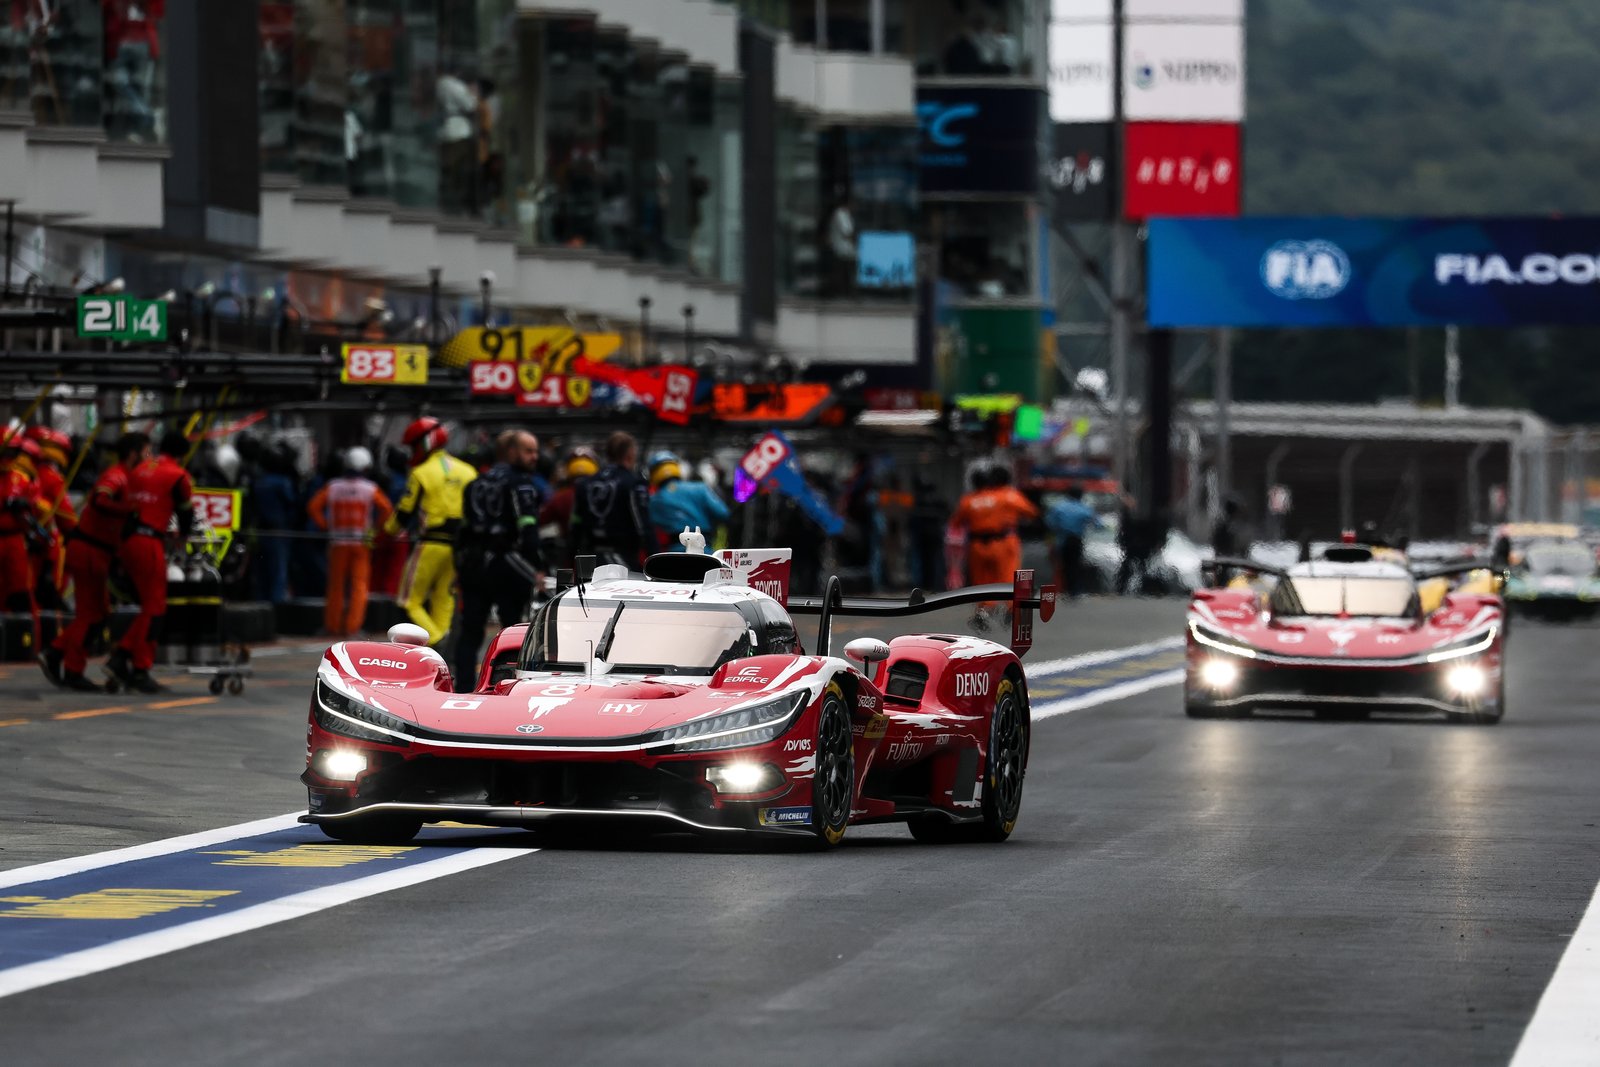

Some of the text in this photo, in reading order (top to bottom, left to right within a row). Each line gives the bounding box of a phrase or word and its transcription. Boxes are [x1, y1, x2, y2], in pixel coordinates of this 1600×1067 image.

[1265, 251, 1341, 289] FIA
[1435, 252, 1600, 285] FIA.CO
[480, 328, 526, 362] 91
[349, 349, 396, 379] 83
[472, 362, 516, 390] 50
[522, 376, 564, 402] 1
[742, 437, 787, 482] 50
[592, 586, 689, 596] DENSO
[754, 580, 783, 602] TOYOTA
[358, 657, 408, 670] CASIO
[540, 684, 577, 696] 8
[723, 676, 769, 684] EDIFICE
[955, 672, 989, 697] DENSO
[602, 703, 643, 713] HY
[886, 743, 924, 763] FUJITSU
[778, 812, 809, 821] MICHELIN
